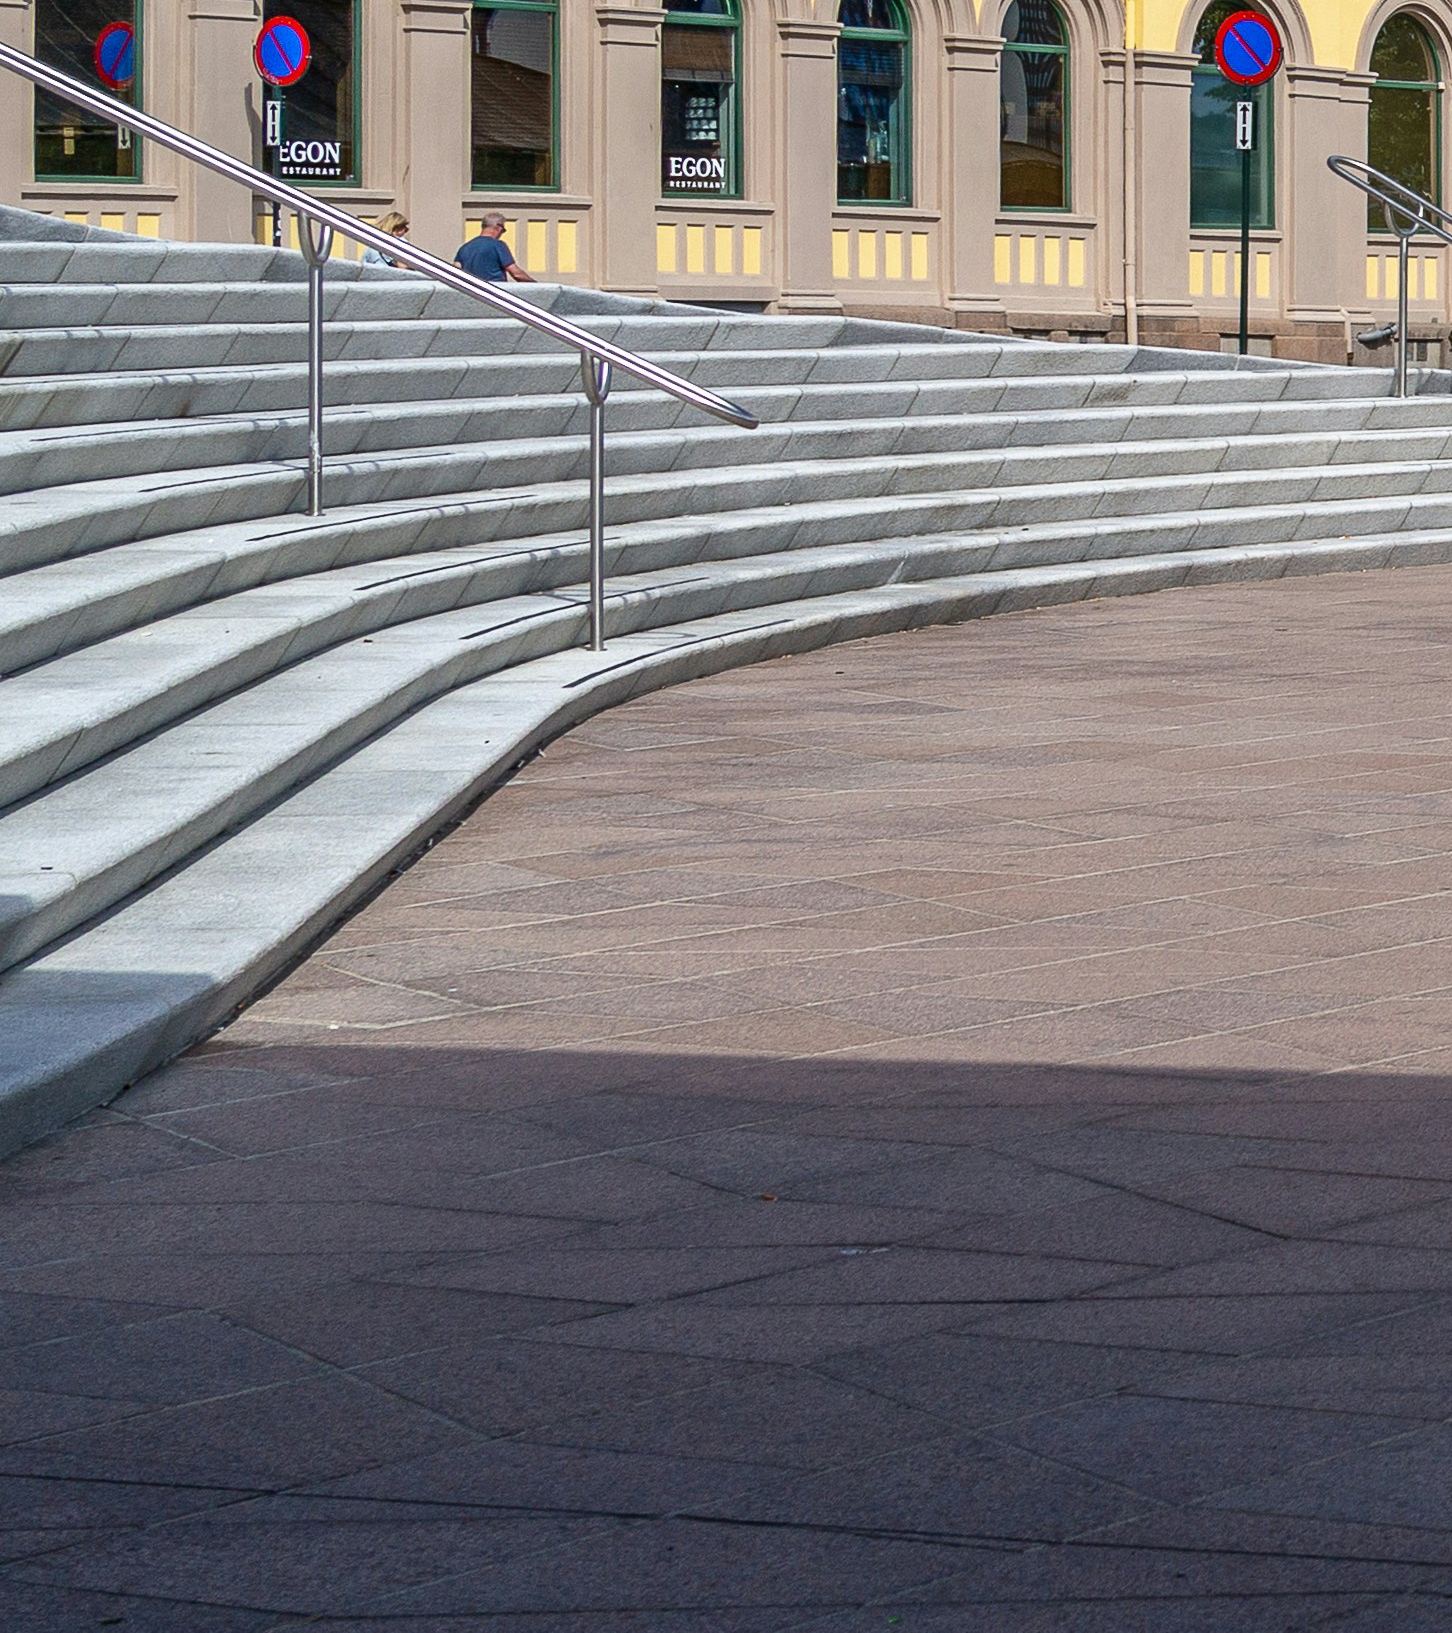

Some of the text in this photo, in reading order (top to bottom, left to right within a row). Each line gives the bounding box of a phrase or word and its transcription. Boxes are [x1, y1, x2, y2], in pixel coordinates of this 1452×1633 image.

[279, 140, 341, 164] EGON
[282, 166, 341, 175] ESTAURANT
[669, 157, 725, 178] EGON
[669, 180, 726, 189] RESTAURANT
